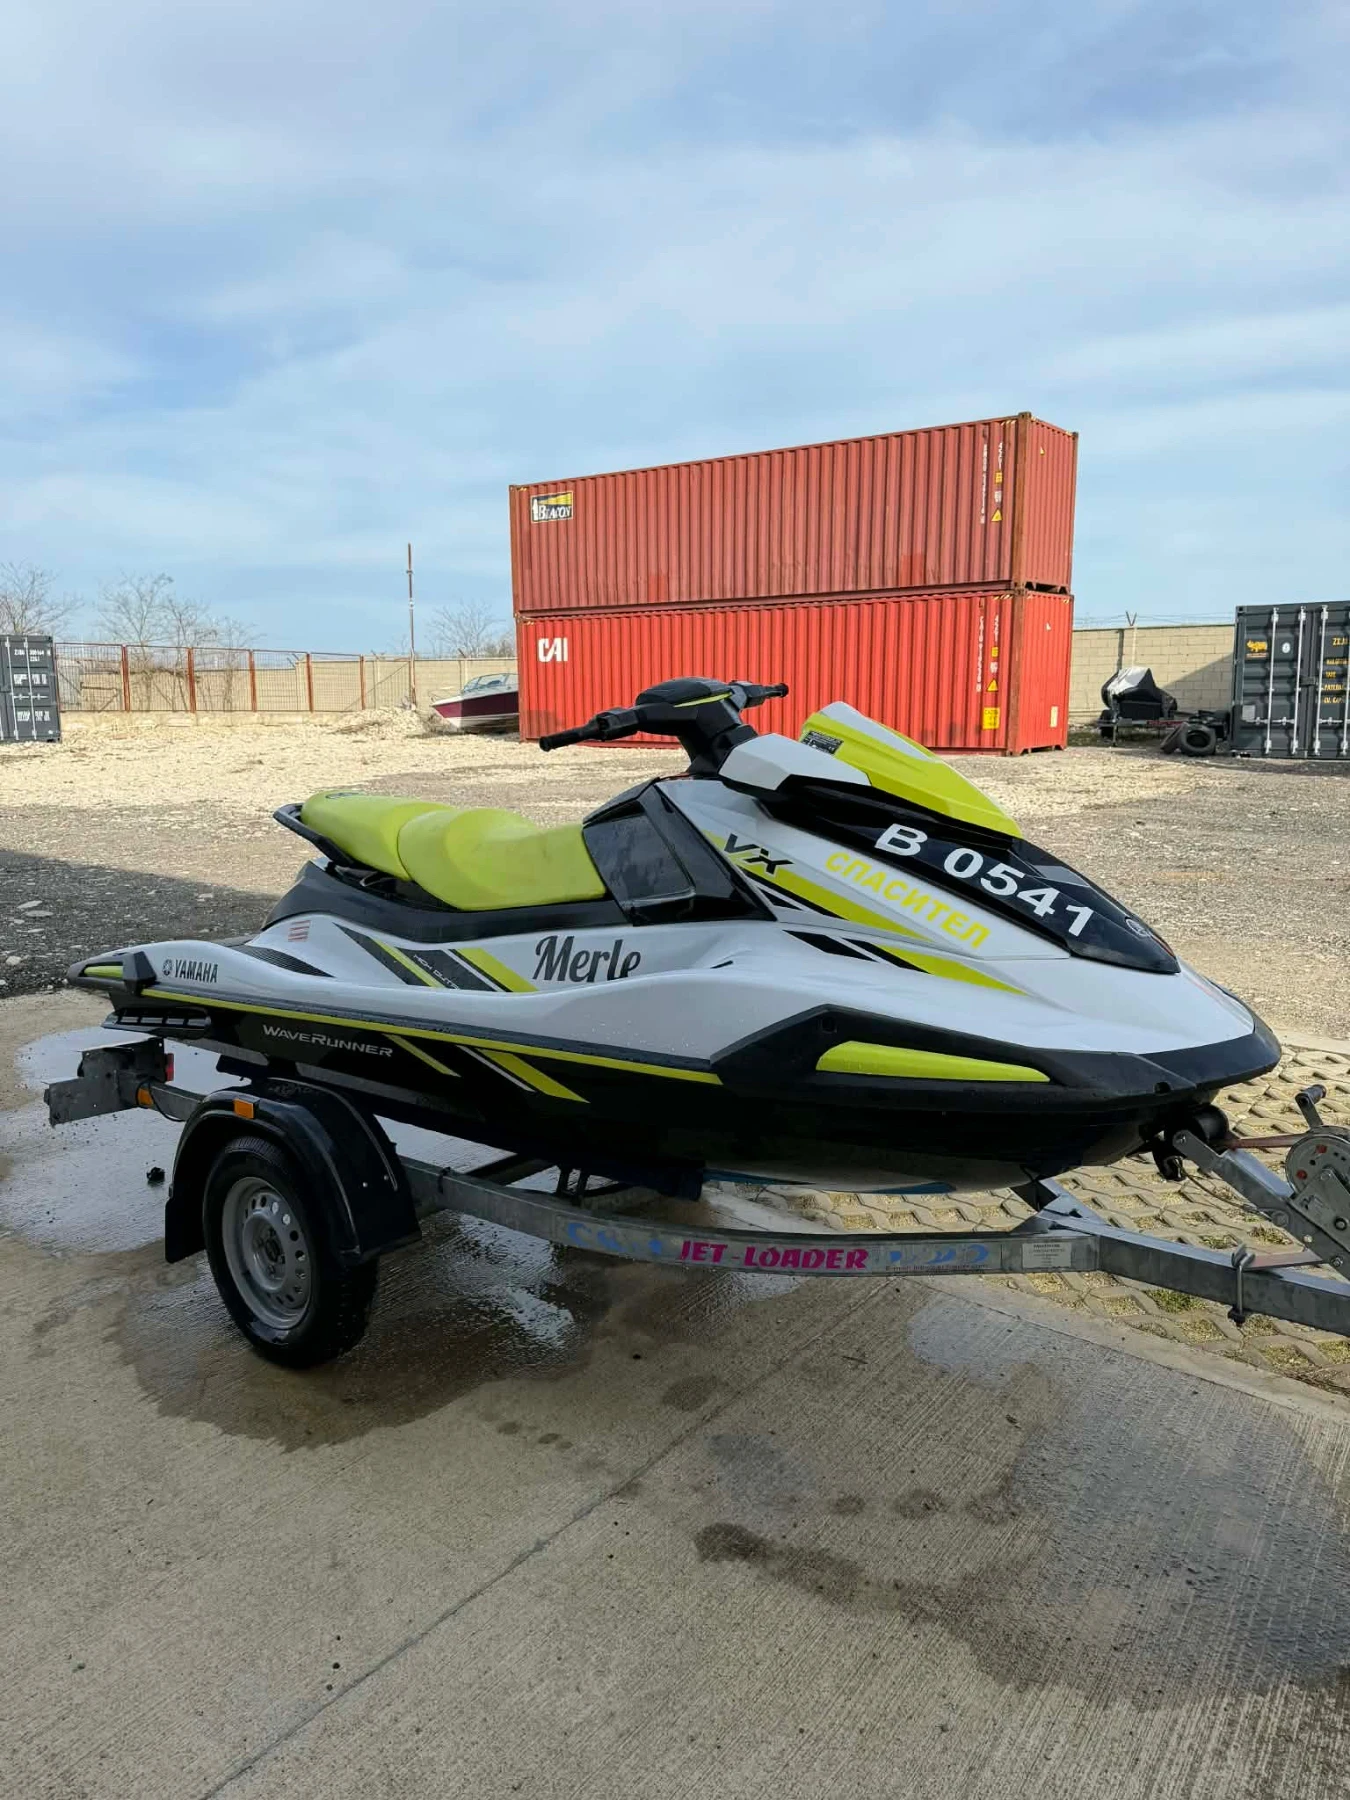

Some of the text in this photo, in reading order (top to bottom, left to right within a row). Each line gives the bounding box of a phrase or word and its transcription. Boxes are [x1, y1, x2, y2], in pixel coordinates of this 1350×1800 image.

[538, 637, 568, 663] CAI
[725, 833, 794, 875] VX
[825, 851, 991, 950] СПАСИТЕЛ
[944, 847, 1095, 938] 0541
[175, 959, 218, 983] YAMAHA
[532, 935, 641, 983] Merle
[263, 1024, 393, 1057] WAVERUNNER
